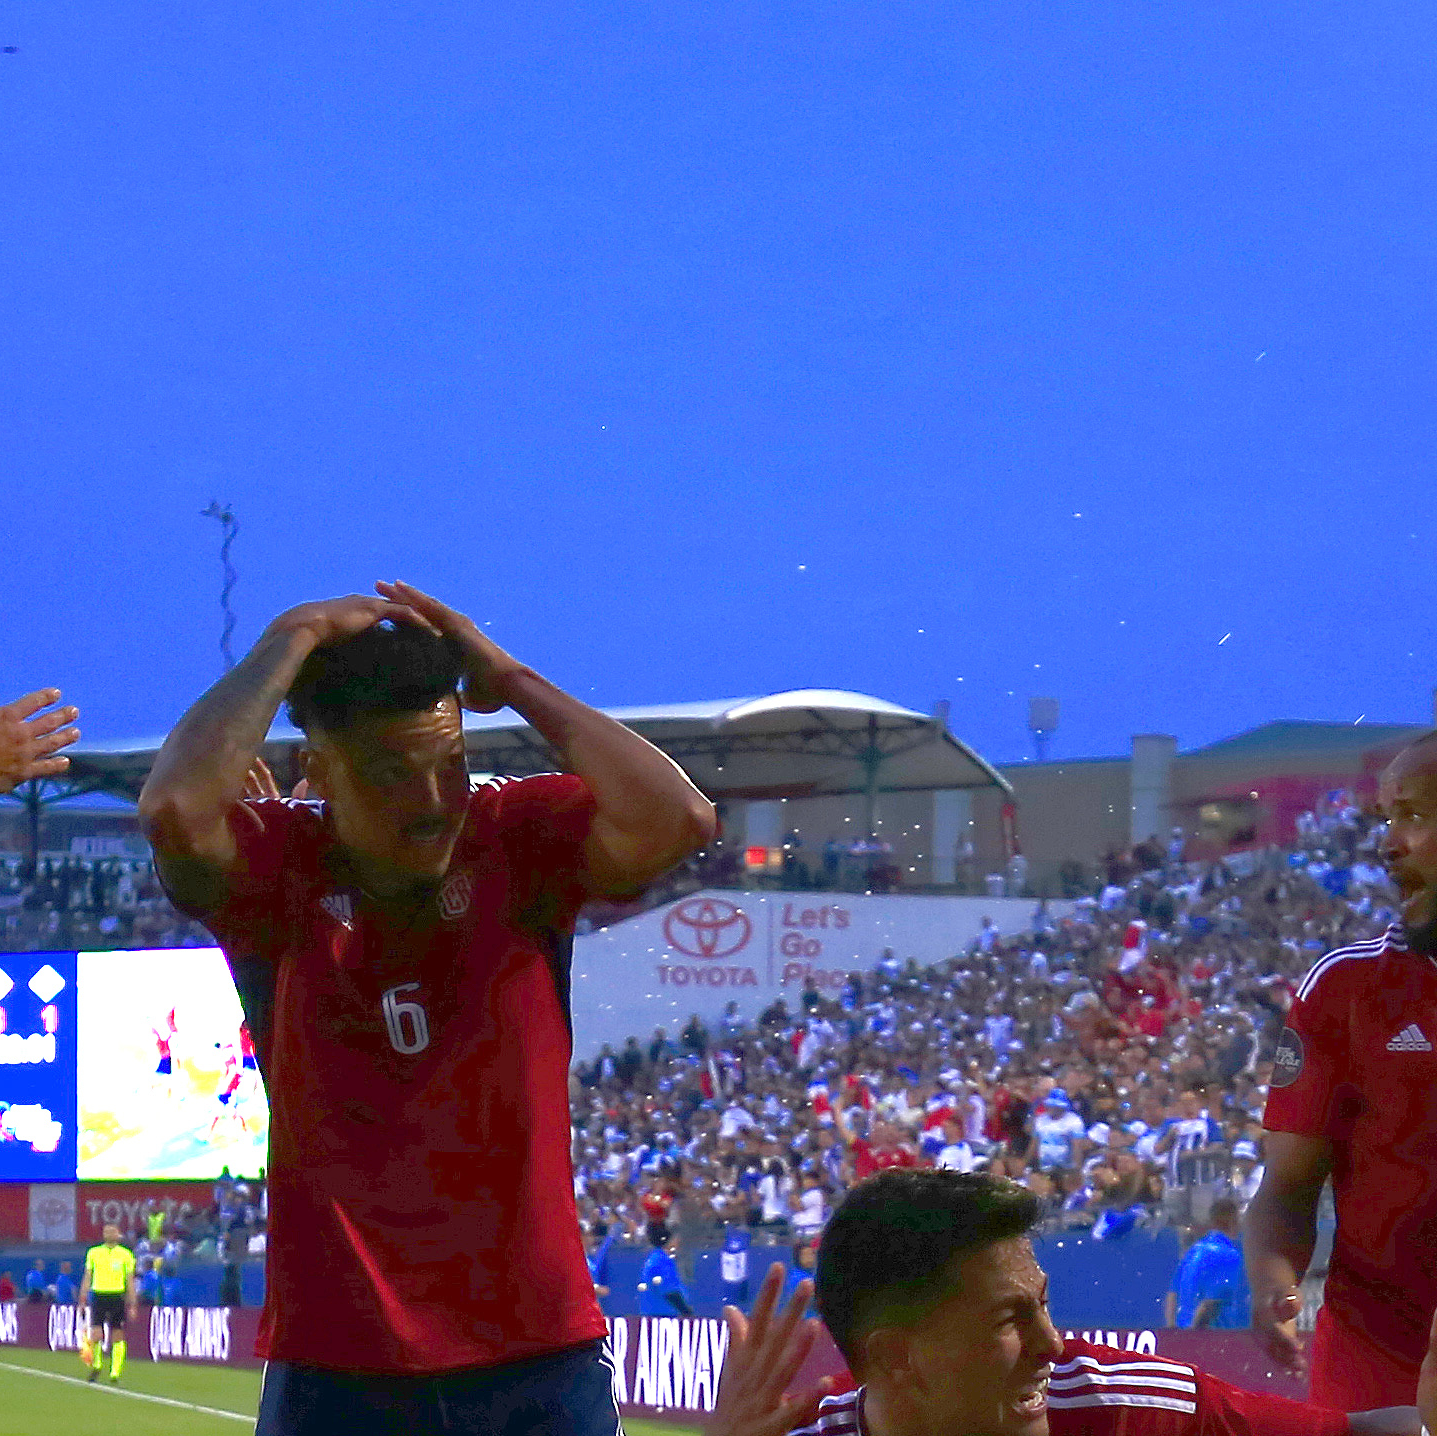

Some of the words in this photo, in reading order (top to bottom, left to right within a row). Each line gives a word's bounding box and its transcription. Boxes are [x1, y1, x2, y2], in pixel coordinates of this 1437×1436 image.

[783, 903, 851, 929] Let's
[780, 931, 822, 957] Go
[657, 965, 758, 988] TOYOTA
[41, 1004, 59, 1034] 1
[382, 980, 431, 1055] 6
[633, 1316, 730, 1413] AIRWAY
